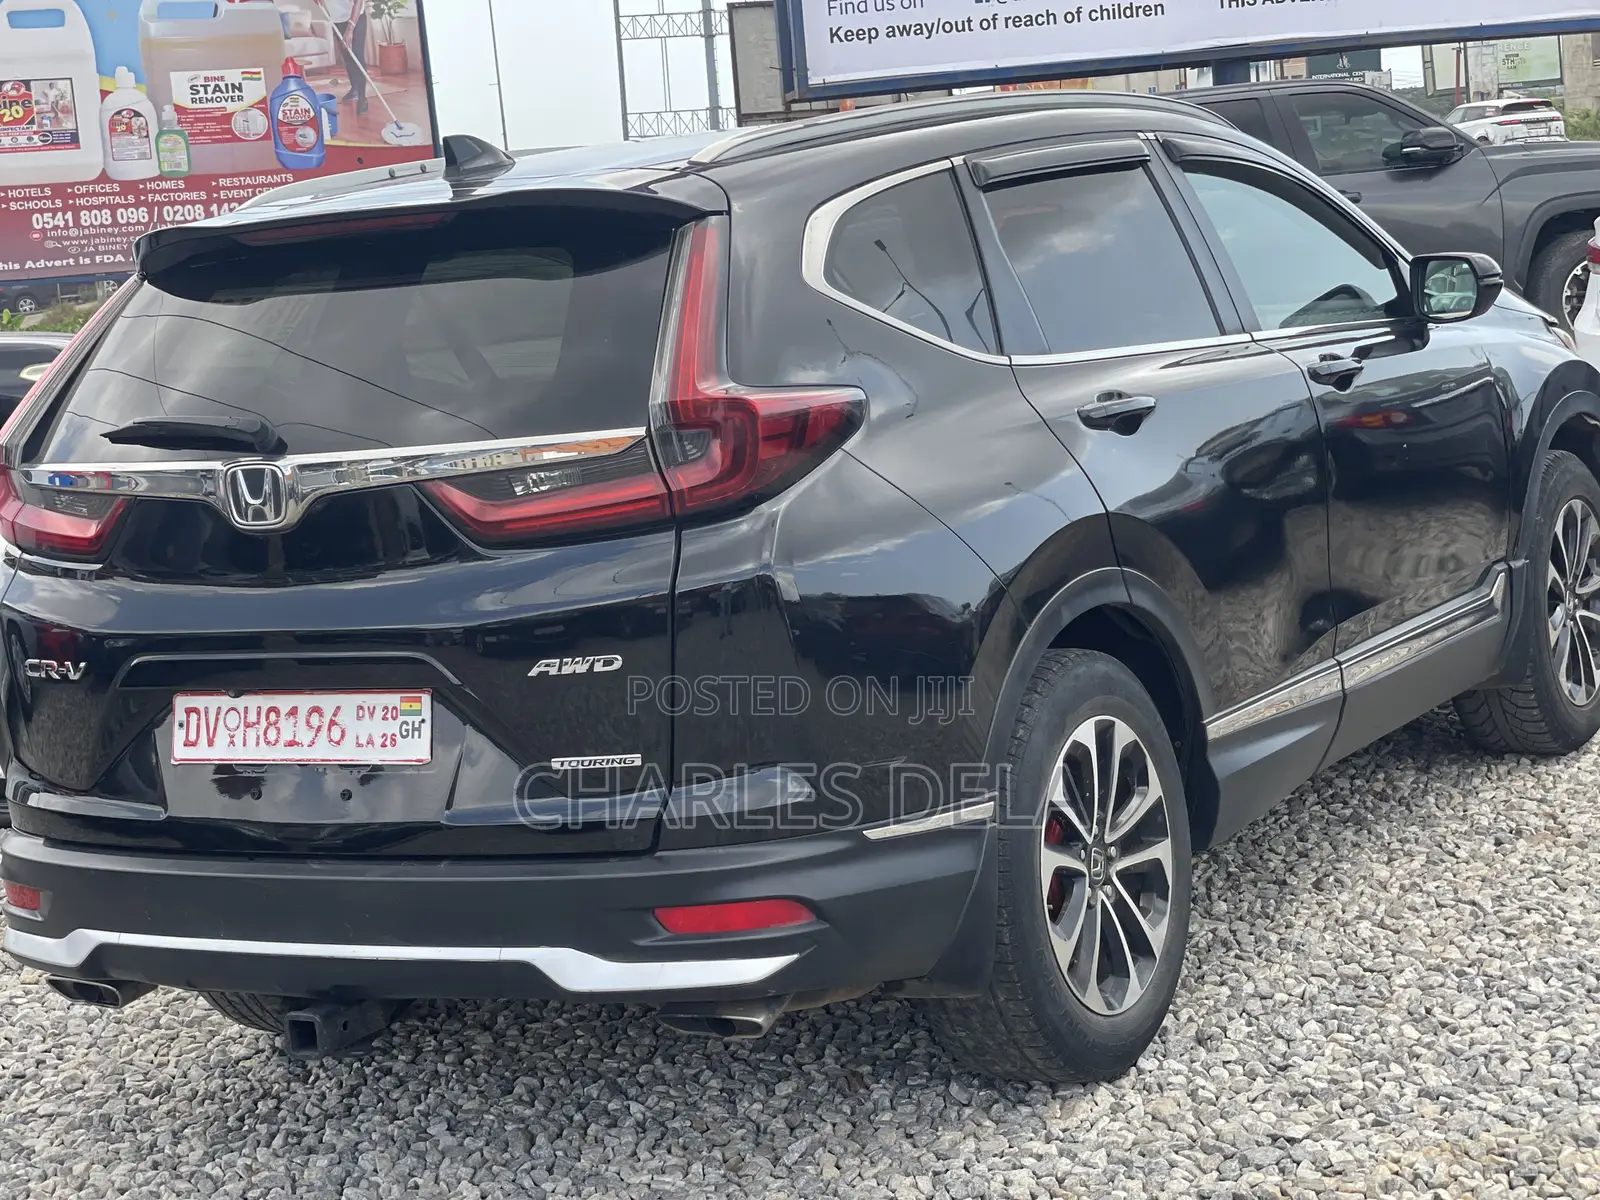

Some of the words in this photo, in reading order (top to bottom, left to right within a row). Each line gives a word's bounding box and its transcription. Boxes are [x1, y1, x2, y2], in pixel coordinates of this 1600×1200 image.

[827, 0, 868, 16] Find
[874, 0, 895, 12] us
[900, 0, 924, 9] on
[829, 26, 879, 44] Keep
[885, 16, 974, 39] away/out
[979, 13, 998, 31] of
[1004, 9, 1057, 29] reach
[1063, 6, 1083, 24] of
[1088, 2, 1165, 22] children
[203, 75, 226, 83] BINE
[189, 82, 244, 96] STAIN
[0, 94, 33, 109] ine
[191, 95, 244, 104] REMOVER
[0, 105, 24, 122] 20
[281, 107, 311, 116] STAIN
[146, 180, 185, 190] HOMES
[219, 174, 293, 187] RESTAURANTS
[8, 187, 52, 198] HOTELS
[74, 183, 120, 194] OFFICES
[220, 188, 253, 199] EVENT
[76, 195, 135, 206] HOSPITALS
[148, 191, 207, 202] FACTORIES
[9, 199, 62, 211] SCHOOLS
[32, 211, 74, 229] 0541
[80, 209, 112, 226] 808
[117, 207, 149, 224] 096
[163, 204, 205, 221] 0208
[47, 225, 145, 237] info@jabiney.com
[0, 261, 20, 270] his
[24, 258, 75, 269] Advert
[79, 256, 91, 265] is
[95, 254, 125, 263] FDA
[24, 658, 88, 680] CR-V
[527, 655, 623, 676] AWD
[356, 705, 376, 721] DV
[381, 705, 399, 721] 20
[399, 720, 422, 739] GH
[355, 732, 375, 748] LA
[558, 757, 636, 768] TOURING
